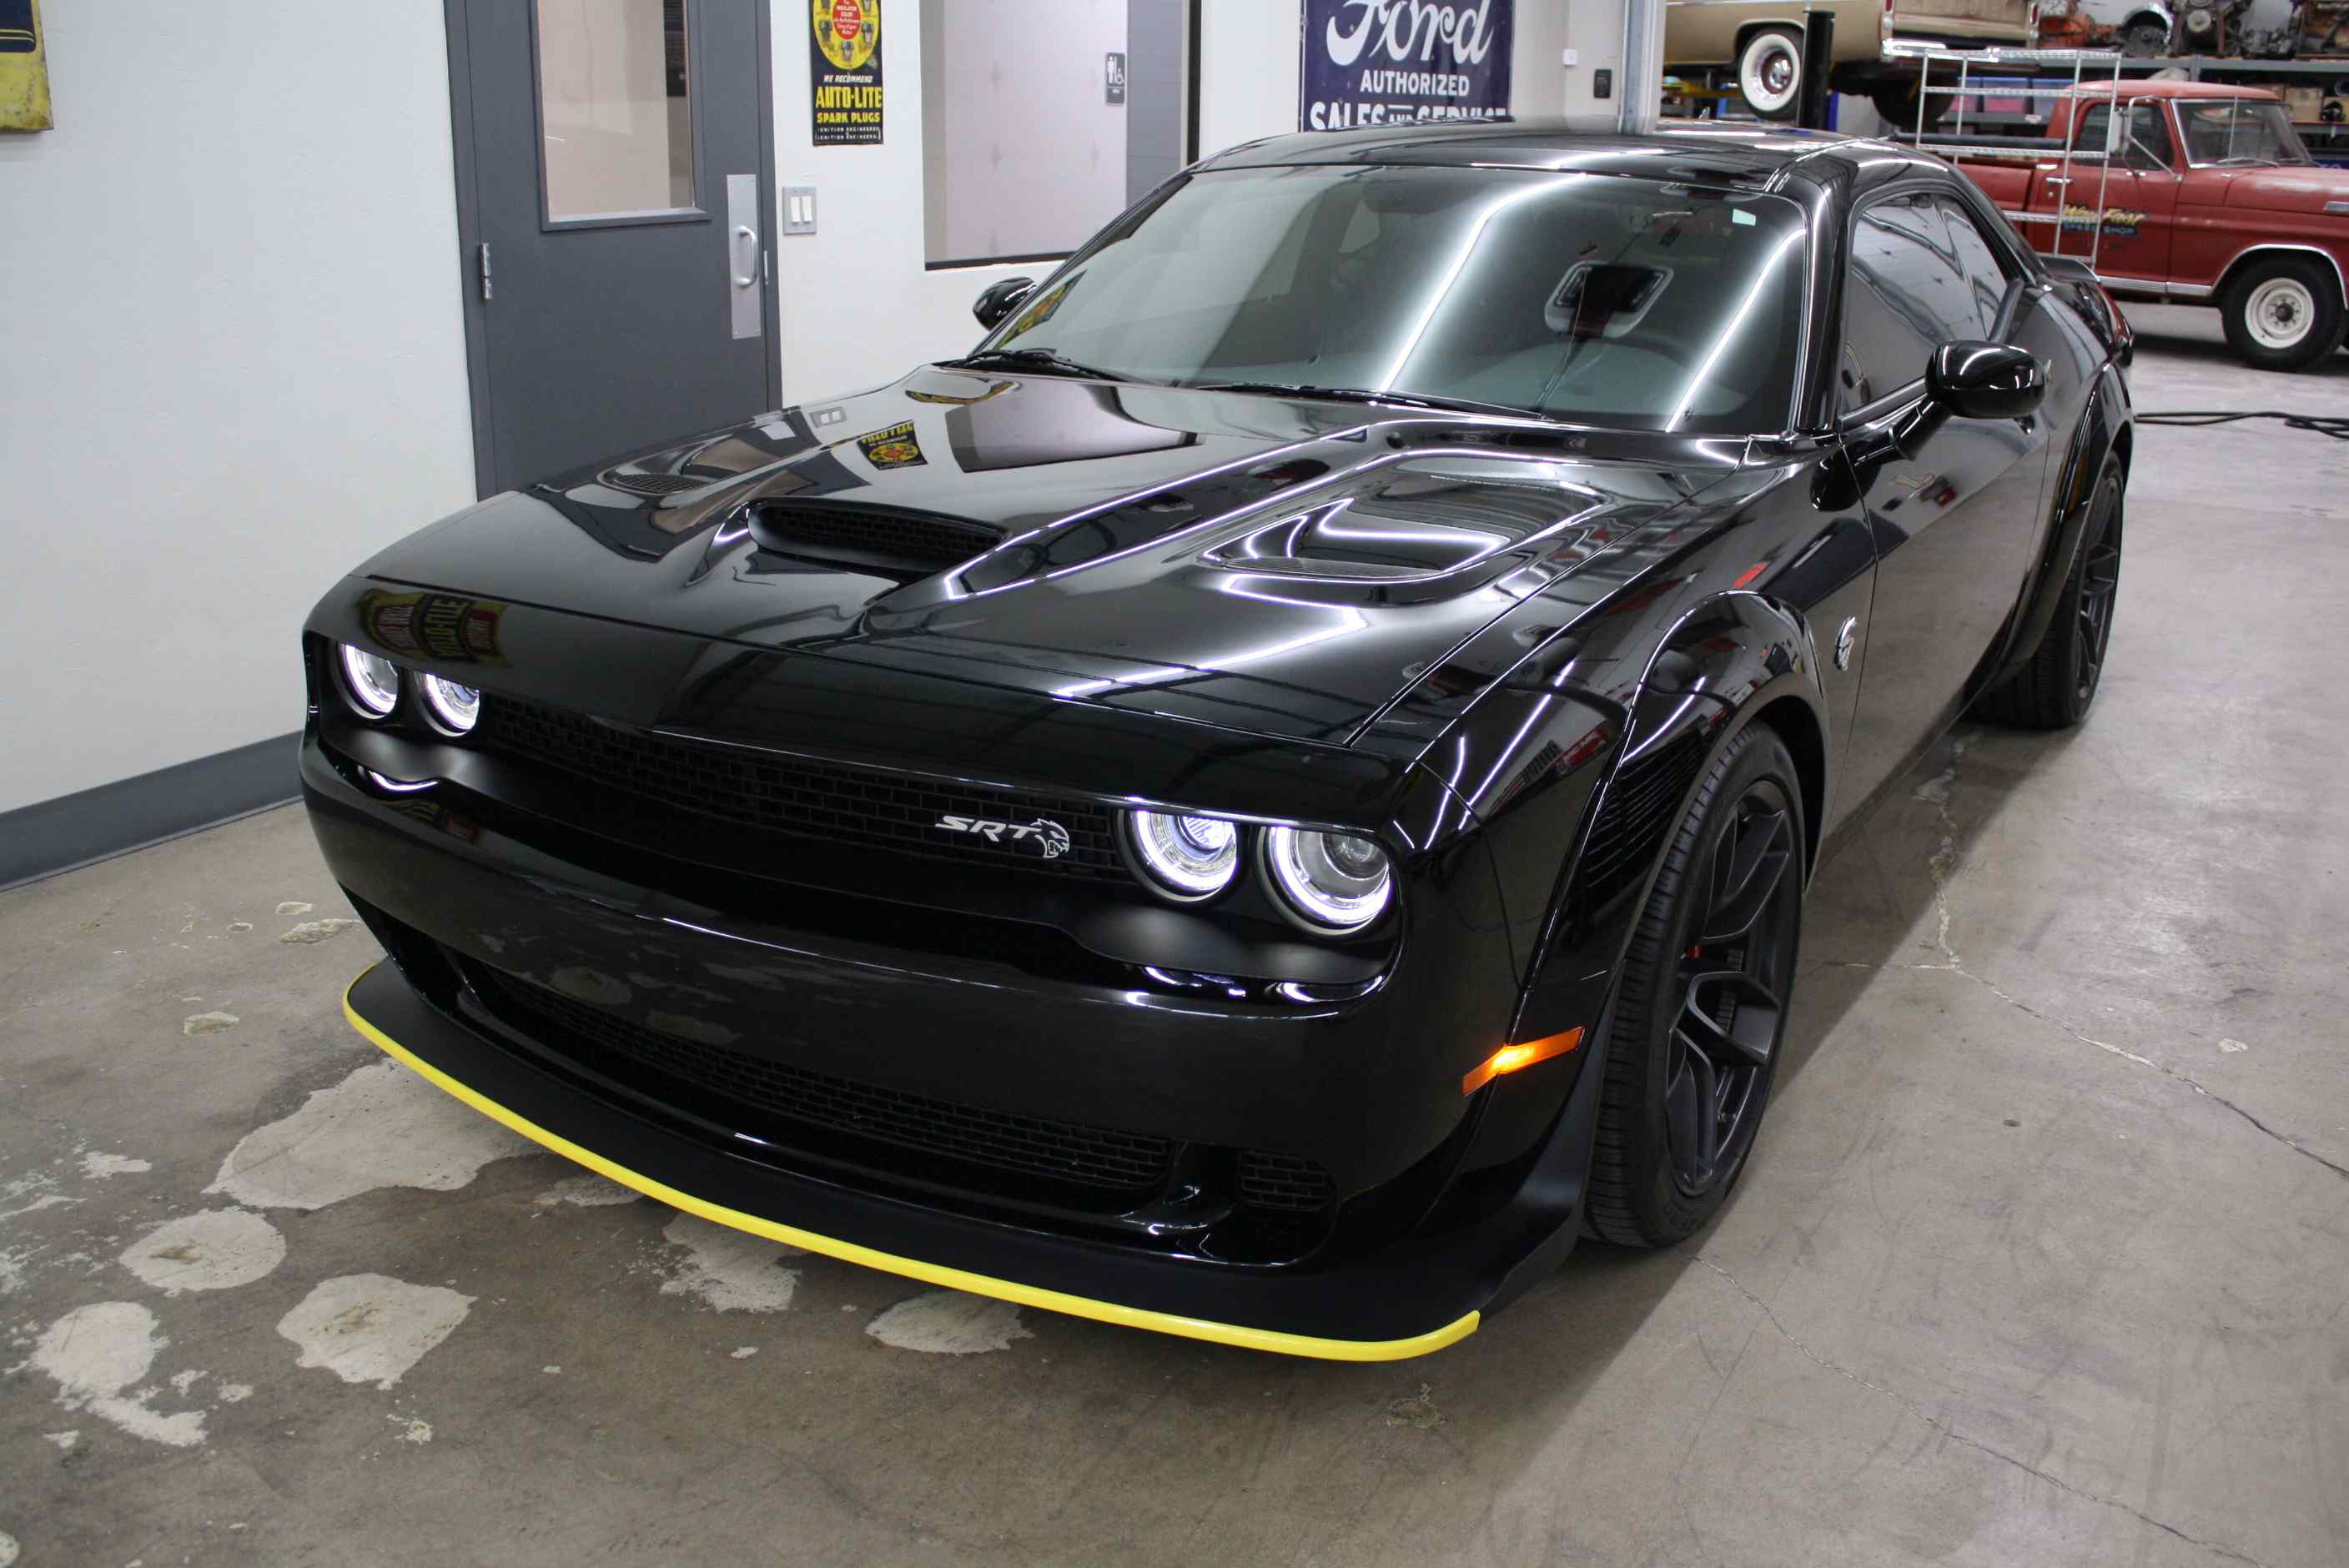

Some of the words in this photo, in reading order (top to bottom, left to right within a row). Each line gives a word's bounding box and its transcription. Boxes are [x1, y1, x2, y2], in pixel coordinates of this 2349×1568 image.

[1326, 0, 1494, 66] Ford
[823, 74, 834, 83] WE
[835, 74, 873, 83] RECOMMEND
[1360, 69, 1471, 98] AUTHORIZED
[817, 112, 848, 124] SPARK
[850, 112, 881, 124] PLUGS
[1310, 101, 1386, 130] SALES
[934, 816, 1042, 842] SRT
